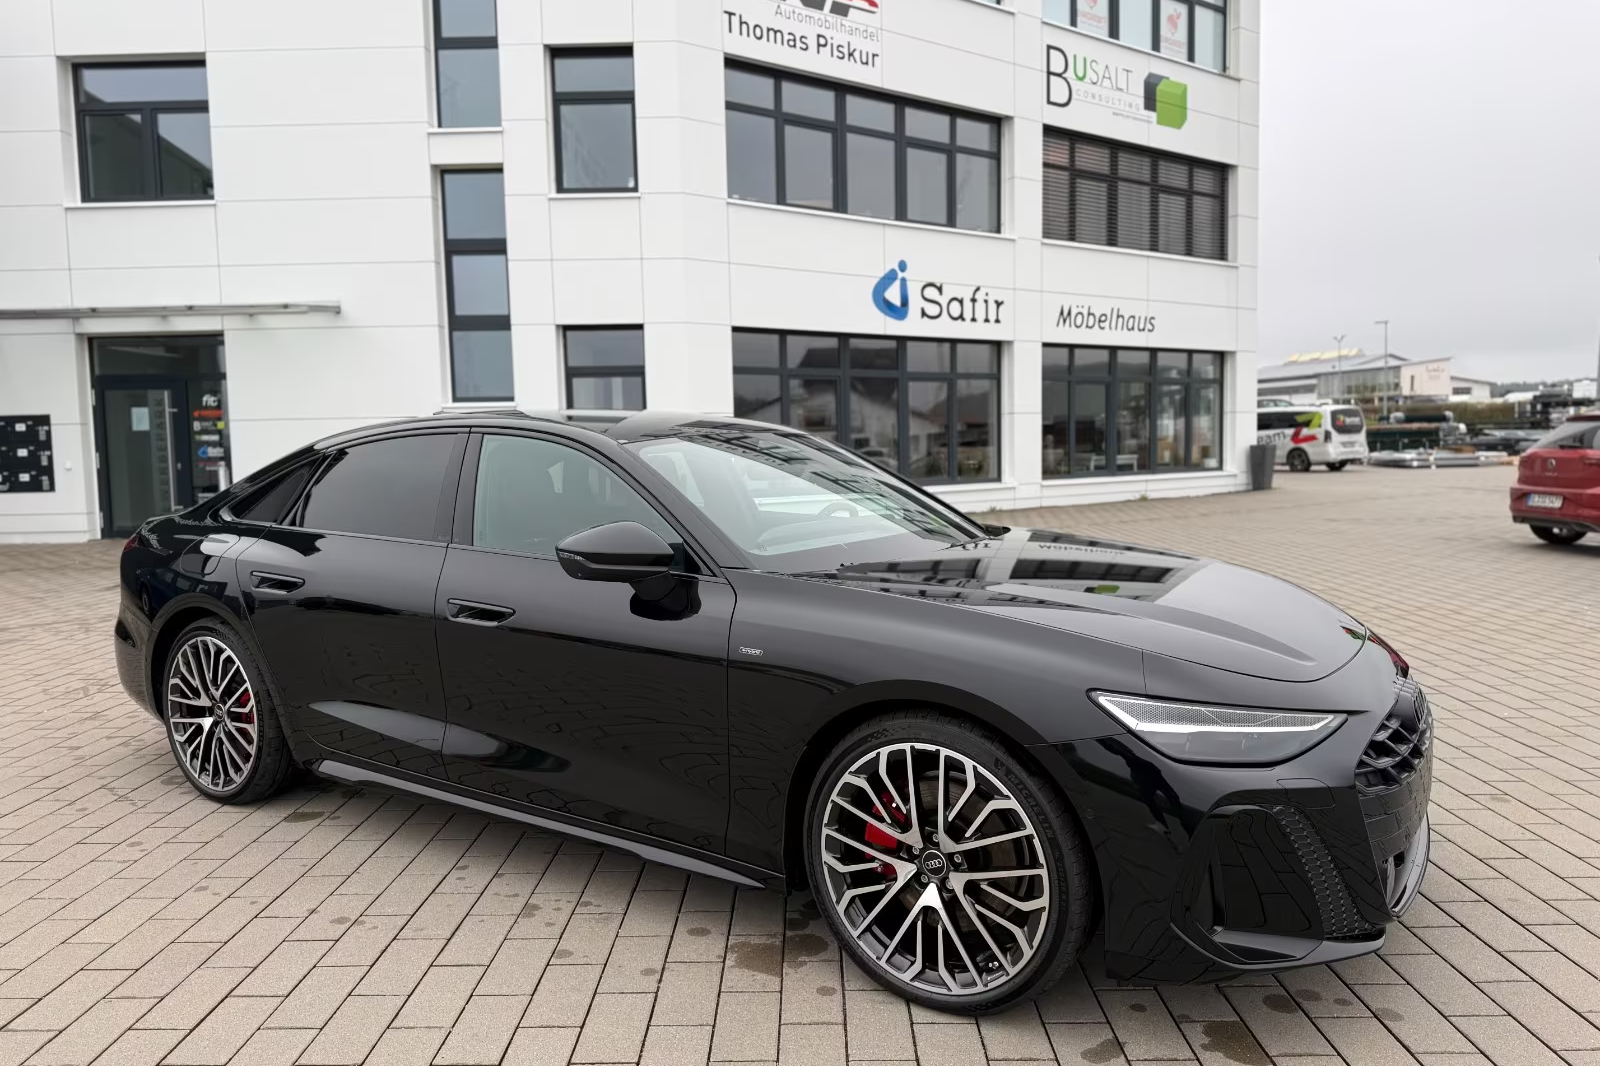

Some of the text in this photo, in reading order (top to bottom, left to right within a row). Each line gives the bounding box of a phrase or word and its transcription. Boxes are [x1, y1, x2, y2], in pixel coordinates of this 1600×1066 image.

[723, 10, 809, 52] Thomas
[816, 33, 881, 68] Piskur
[774, 4, 880, 42] Automobilhandel
[1046, 44, 1133, 108] BUSALT
[1076, 88, 1141, 111] CONSULTING
[920, 282, 1004, 324] Safir
[1056, 304, 1156, 333] Möbelhaus
